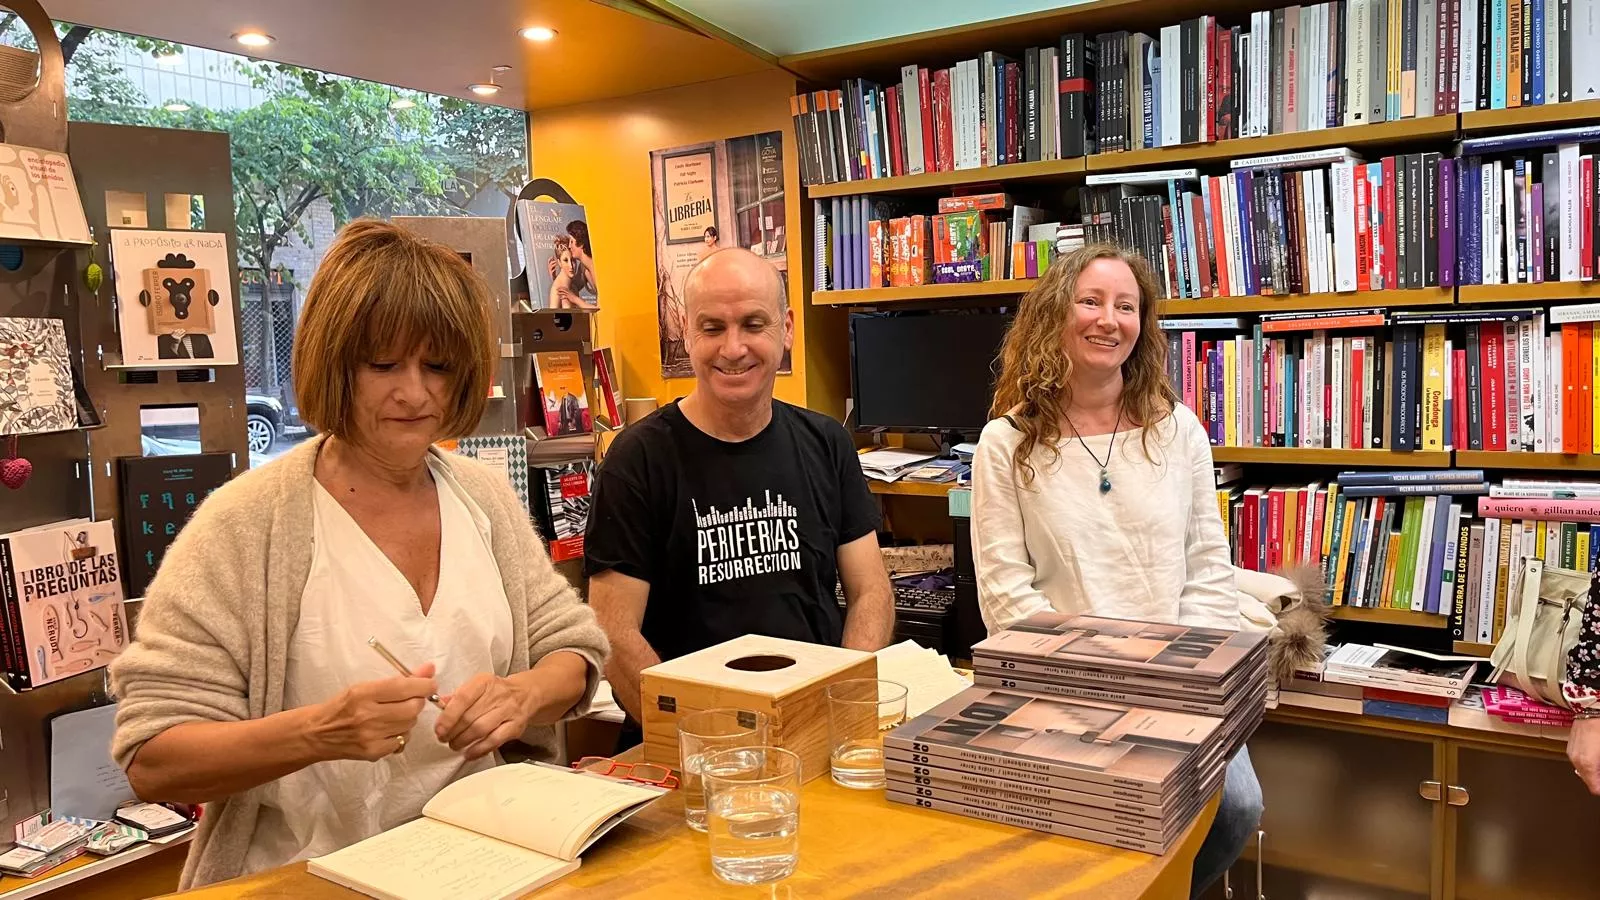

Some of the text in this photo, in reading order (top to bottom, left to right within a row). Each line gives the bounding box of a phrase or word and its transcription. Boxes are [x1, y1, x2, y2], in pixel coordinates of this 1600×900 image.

[1511, 4, 1519, 53] LA PLANTA BAJA
[1144, 90, 1152, 113] MAQUIS!
[27, 157, 66, 168] enciclopedia
[41, 172, 64, 182] sonidos
[531, 215, 562, 223] LENGUAJE
[669, 196, 712, 223] LIBRERÍA
[1359, 256, 1367, 274] MAXIM
[1522, 338, 1530, 363] CORNELIUS
[1522, 384, 1530, 394] MÁS
[1432, 390, 1441, 428] Covadonga
[1494, 504, 1573, 516] quiero gillian
[697, 519, 799, 564] PERIFERIAS
[22, 554, 116, 585] LIBRO DE LAS
[698, 551, 801, 585] RESURRECTION
[1455, 527, 1468, 625] LA GUERRA DE LOS MUNDOS
[24, 567, 117, 603] PREGUNTAS
[45, 618, 58, 654] NERUDA
[1062, 668, 1077, 676] isidro
[1083, 670, 1109, 680] carbonell
[1110, 674, 1126, 682] paula
[1044, 685, 1061, 693] ferrer
[1062, 687, 1077, 695] isidro
[1083, 690, 1109, 700] carbonell
[934, 706, 1008, 737] NO
[912, 754, 1049, 783] NO paula carbonell isidro ferrer
[913, 742, 1050, 772] NO paula carbonell isidro ferrer
[913, 766, 1051, 796] NO paula carbonell isidro ferrer
[914, 775, 1051, 807] NO paula carbonell isidro ferrer
[915, 786, 1052, 818] NO paula carbonell isidro ferrer
[915, 798, 1052, 830] NO paula carbonell isidro ferrer
